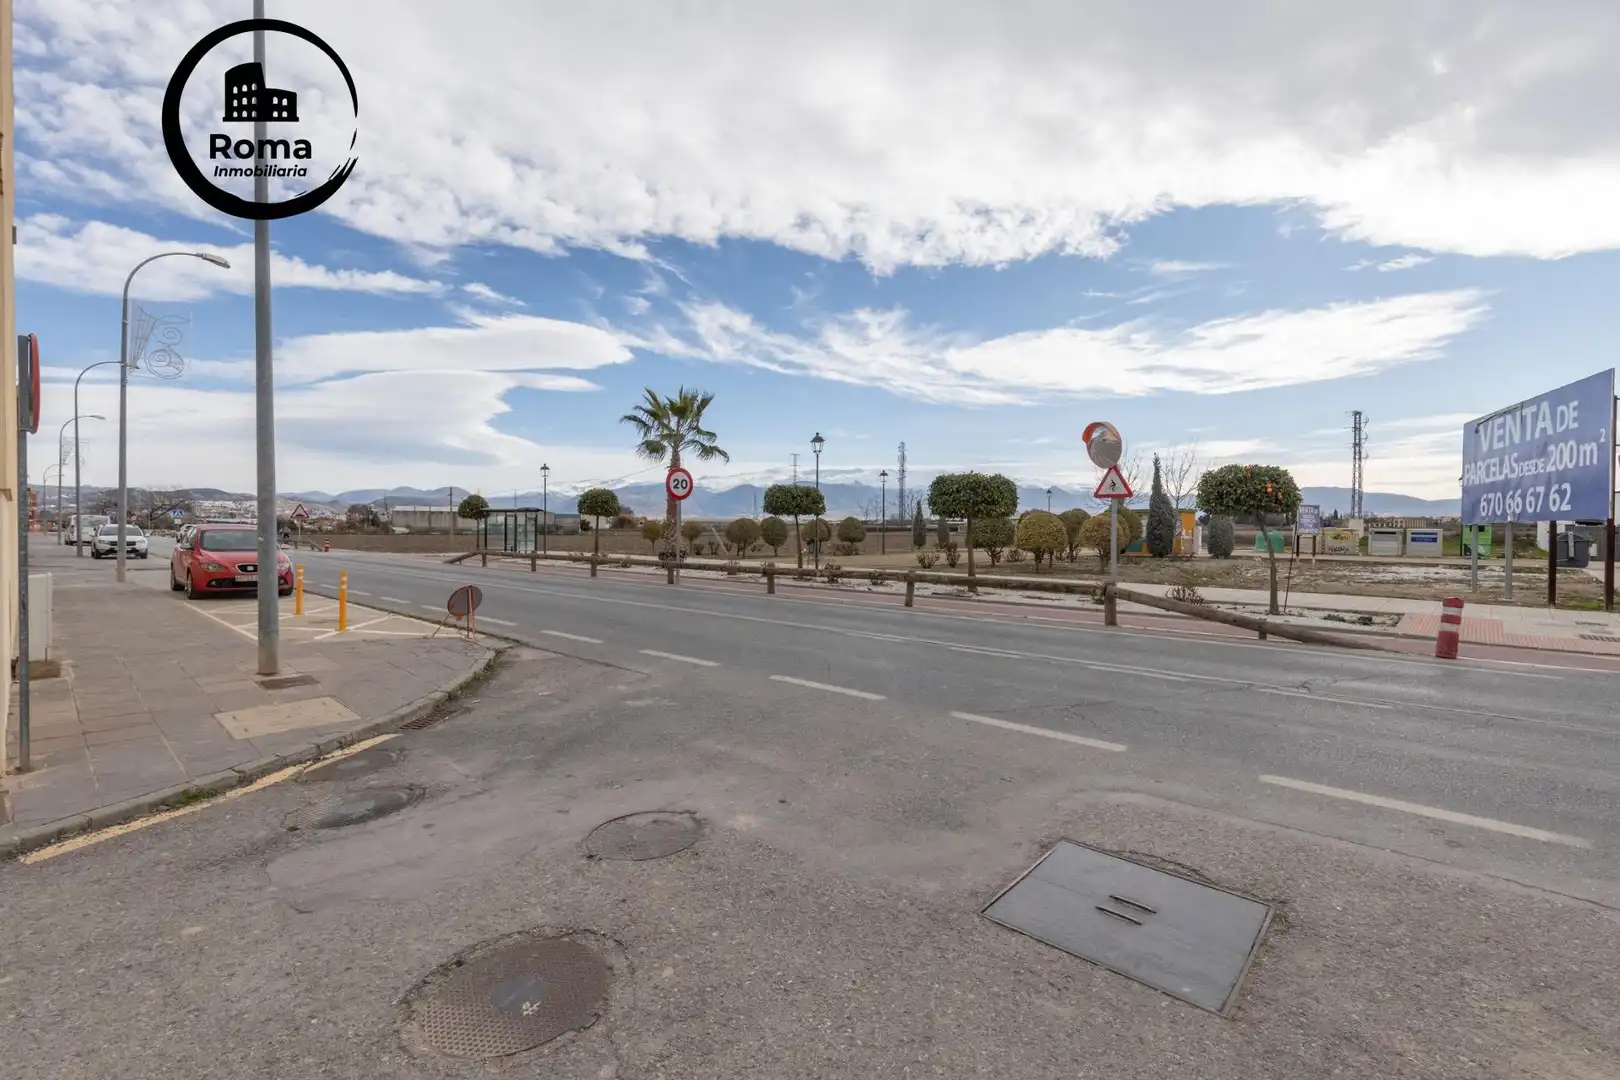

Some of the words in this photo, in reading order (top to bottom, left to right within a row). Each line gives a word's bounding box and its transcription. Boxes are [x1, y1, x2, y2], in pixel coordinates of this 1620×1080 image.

[1479, 401, 1554, 452] VENTA
[1556, 400, 1579, 433] DE
[1463, 452, 1519, 486] PARCELAS
[1519, 458, 1546, 477] DESDE
[1546, 439, 1577, 473] 200
[672, 478, 688, 489] 20
[1479, 492, 1503, 517] 670
[1505, 488, 1523, 515] 66
[1525, 485, 1546, 514] 67
[1549, 482, 1572, 512] 62
